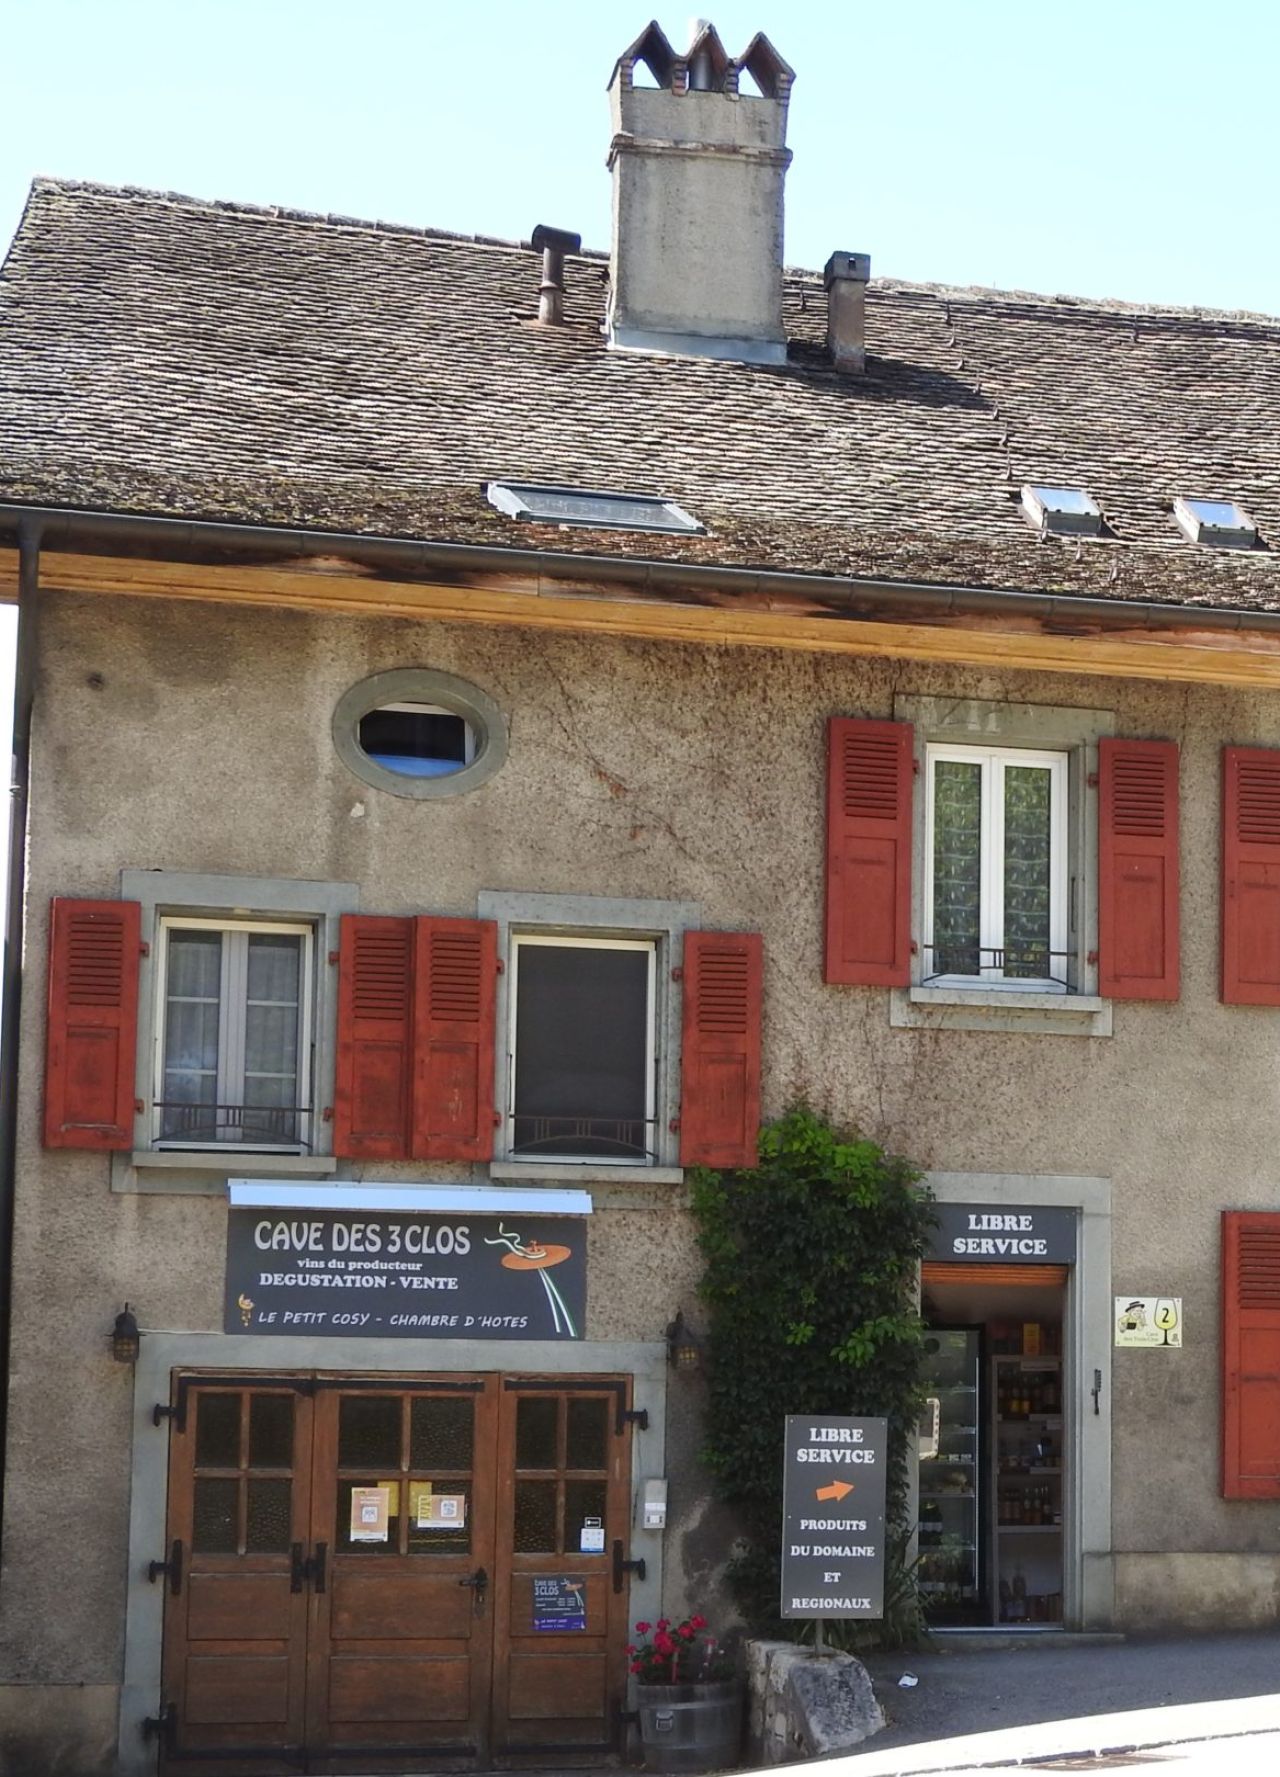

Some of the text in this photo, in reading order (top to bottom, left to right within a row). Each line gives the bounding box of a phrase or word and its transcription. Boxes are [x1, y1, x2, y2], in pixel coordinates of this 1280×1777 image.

[968, 1214, 1033, 1231] LIBRE
[255, 1221, 325, 1251] CAVE
[332, 1222, 382, 1253] DES
[953, 1238, 1047, 1254] SERVICE
[297, 1258, 423, 1271] vins du producteur
[259, 1273, 387, 1287] DEGUSTATION
[400, 1276, 458, 1289] VENTE
[258, 1311, 277, 1323] LE
[283, 1312, 327, 1324] PETIT
[332, 1312, 370, 1325] COSY
[390, 1314, 459, 1327] CHAMBRE
[1162, 1307, 1169, 1323] 2
[809, 1428, 863, 1443] LIBRE
[796, 1449, 875, 1464] SERVICE
[800, 1519, 867, 1531] PRODUITS
[791, 1545, 875, 1557] DU DOMAINE
[824, 1572, 841, 1582] ET
[792, 1598, 871, 1609] REGIONAUX
